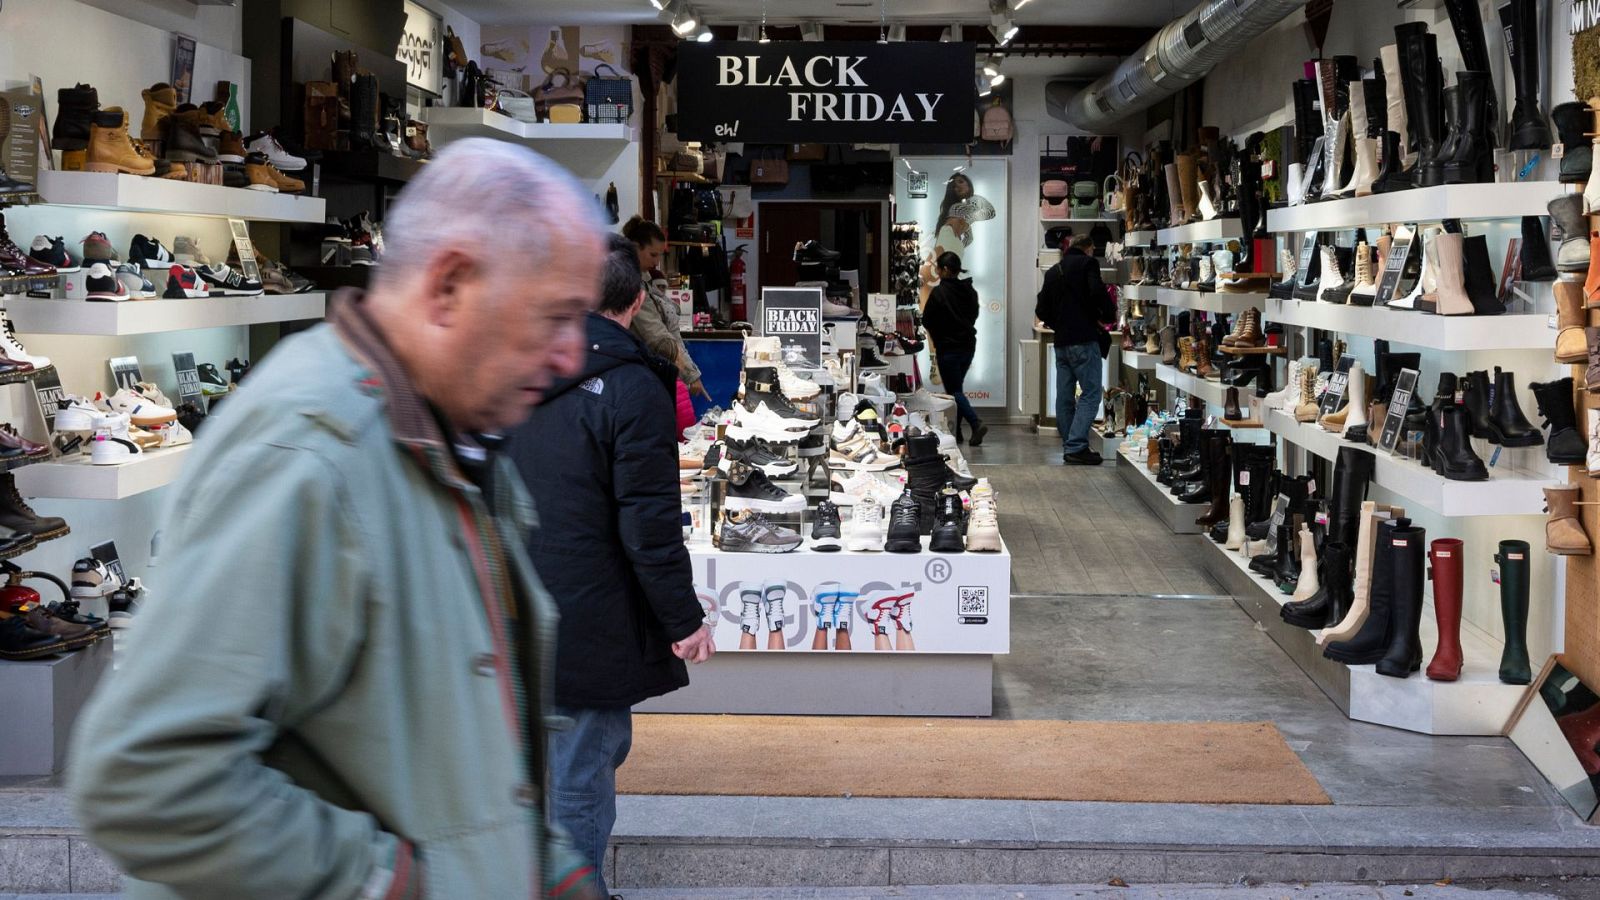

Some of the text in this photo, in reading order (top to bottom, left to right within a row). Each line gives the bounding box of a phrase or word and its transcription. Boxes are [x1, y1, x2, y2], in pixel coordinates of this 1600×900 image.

[716, 55, 869, 86] BLACK
[787, 92, 944, 122] FRIDAY
[714, 119, 740, 137] eh!
[768, 310, 817, 322] BLACK
[768, 321, 817, 332] FRIDAY
